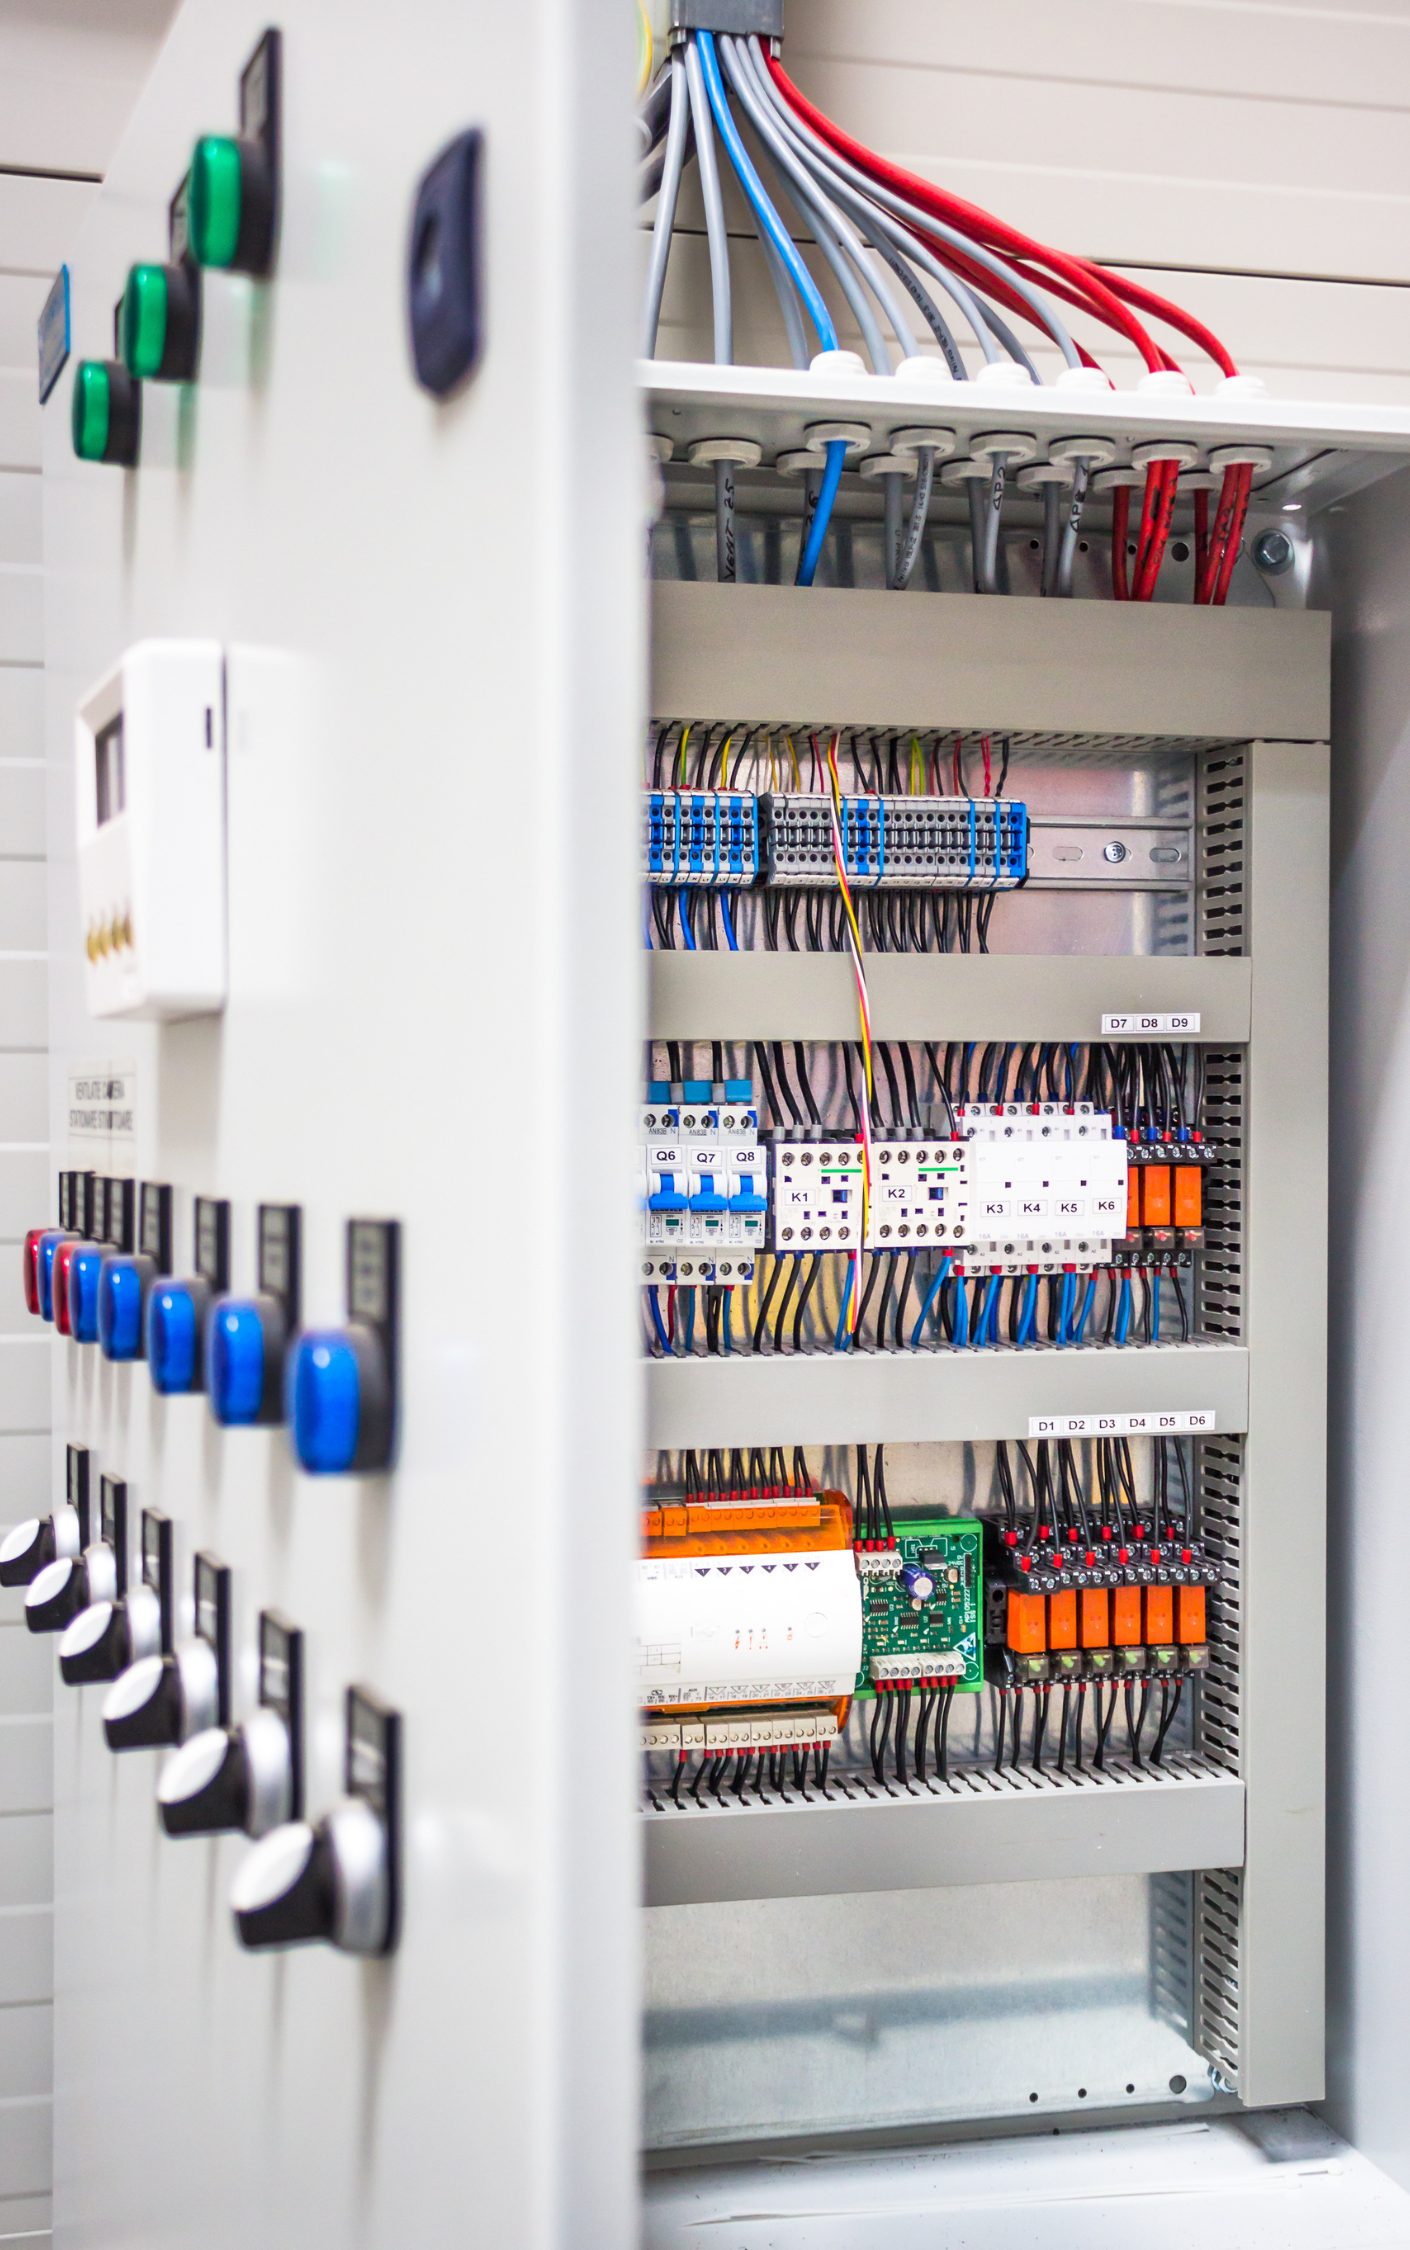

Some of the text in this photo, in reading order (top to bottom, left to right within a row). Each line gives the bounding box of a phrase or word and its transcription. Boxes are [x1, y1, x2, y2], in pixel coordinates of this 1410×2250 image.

[723, 478, 736, 580] VENT 25
[1110, 1018, 1188, 1028] D7 D8 D9
[656, 1151, 755, 1164] Q6 Q7 Q8
[792, 1192, 808, 1202] K1
[888, 1189, 905, 1199] K2
[986, 1204, 1003, 1214] K3
[1024, 1203, 1041, 1213] K4
[1061, 1203, 1078, 1213] K5
[1098, 1201, 1115, 1210] K6
[1039, 1416, 1206, 1431] D1 D2 D3 D4 D5 D6
